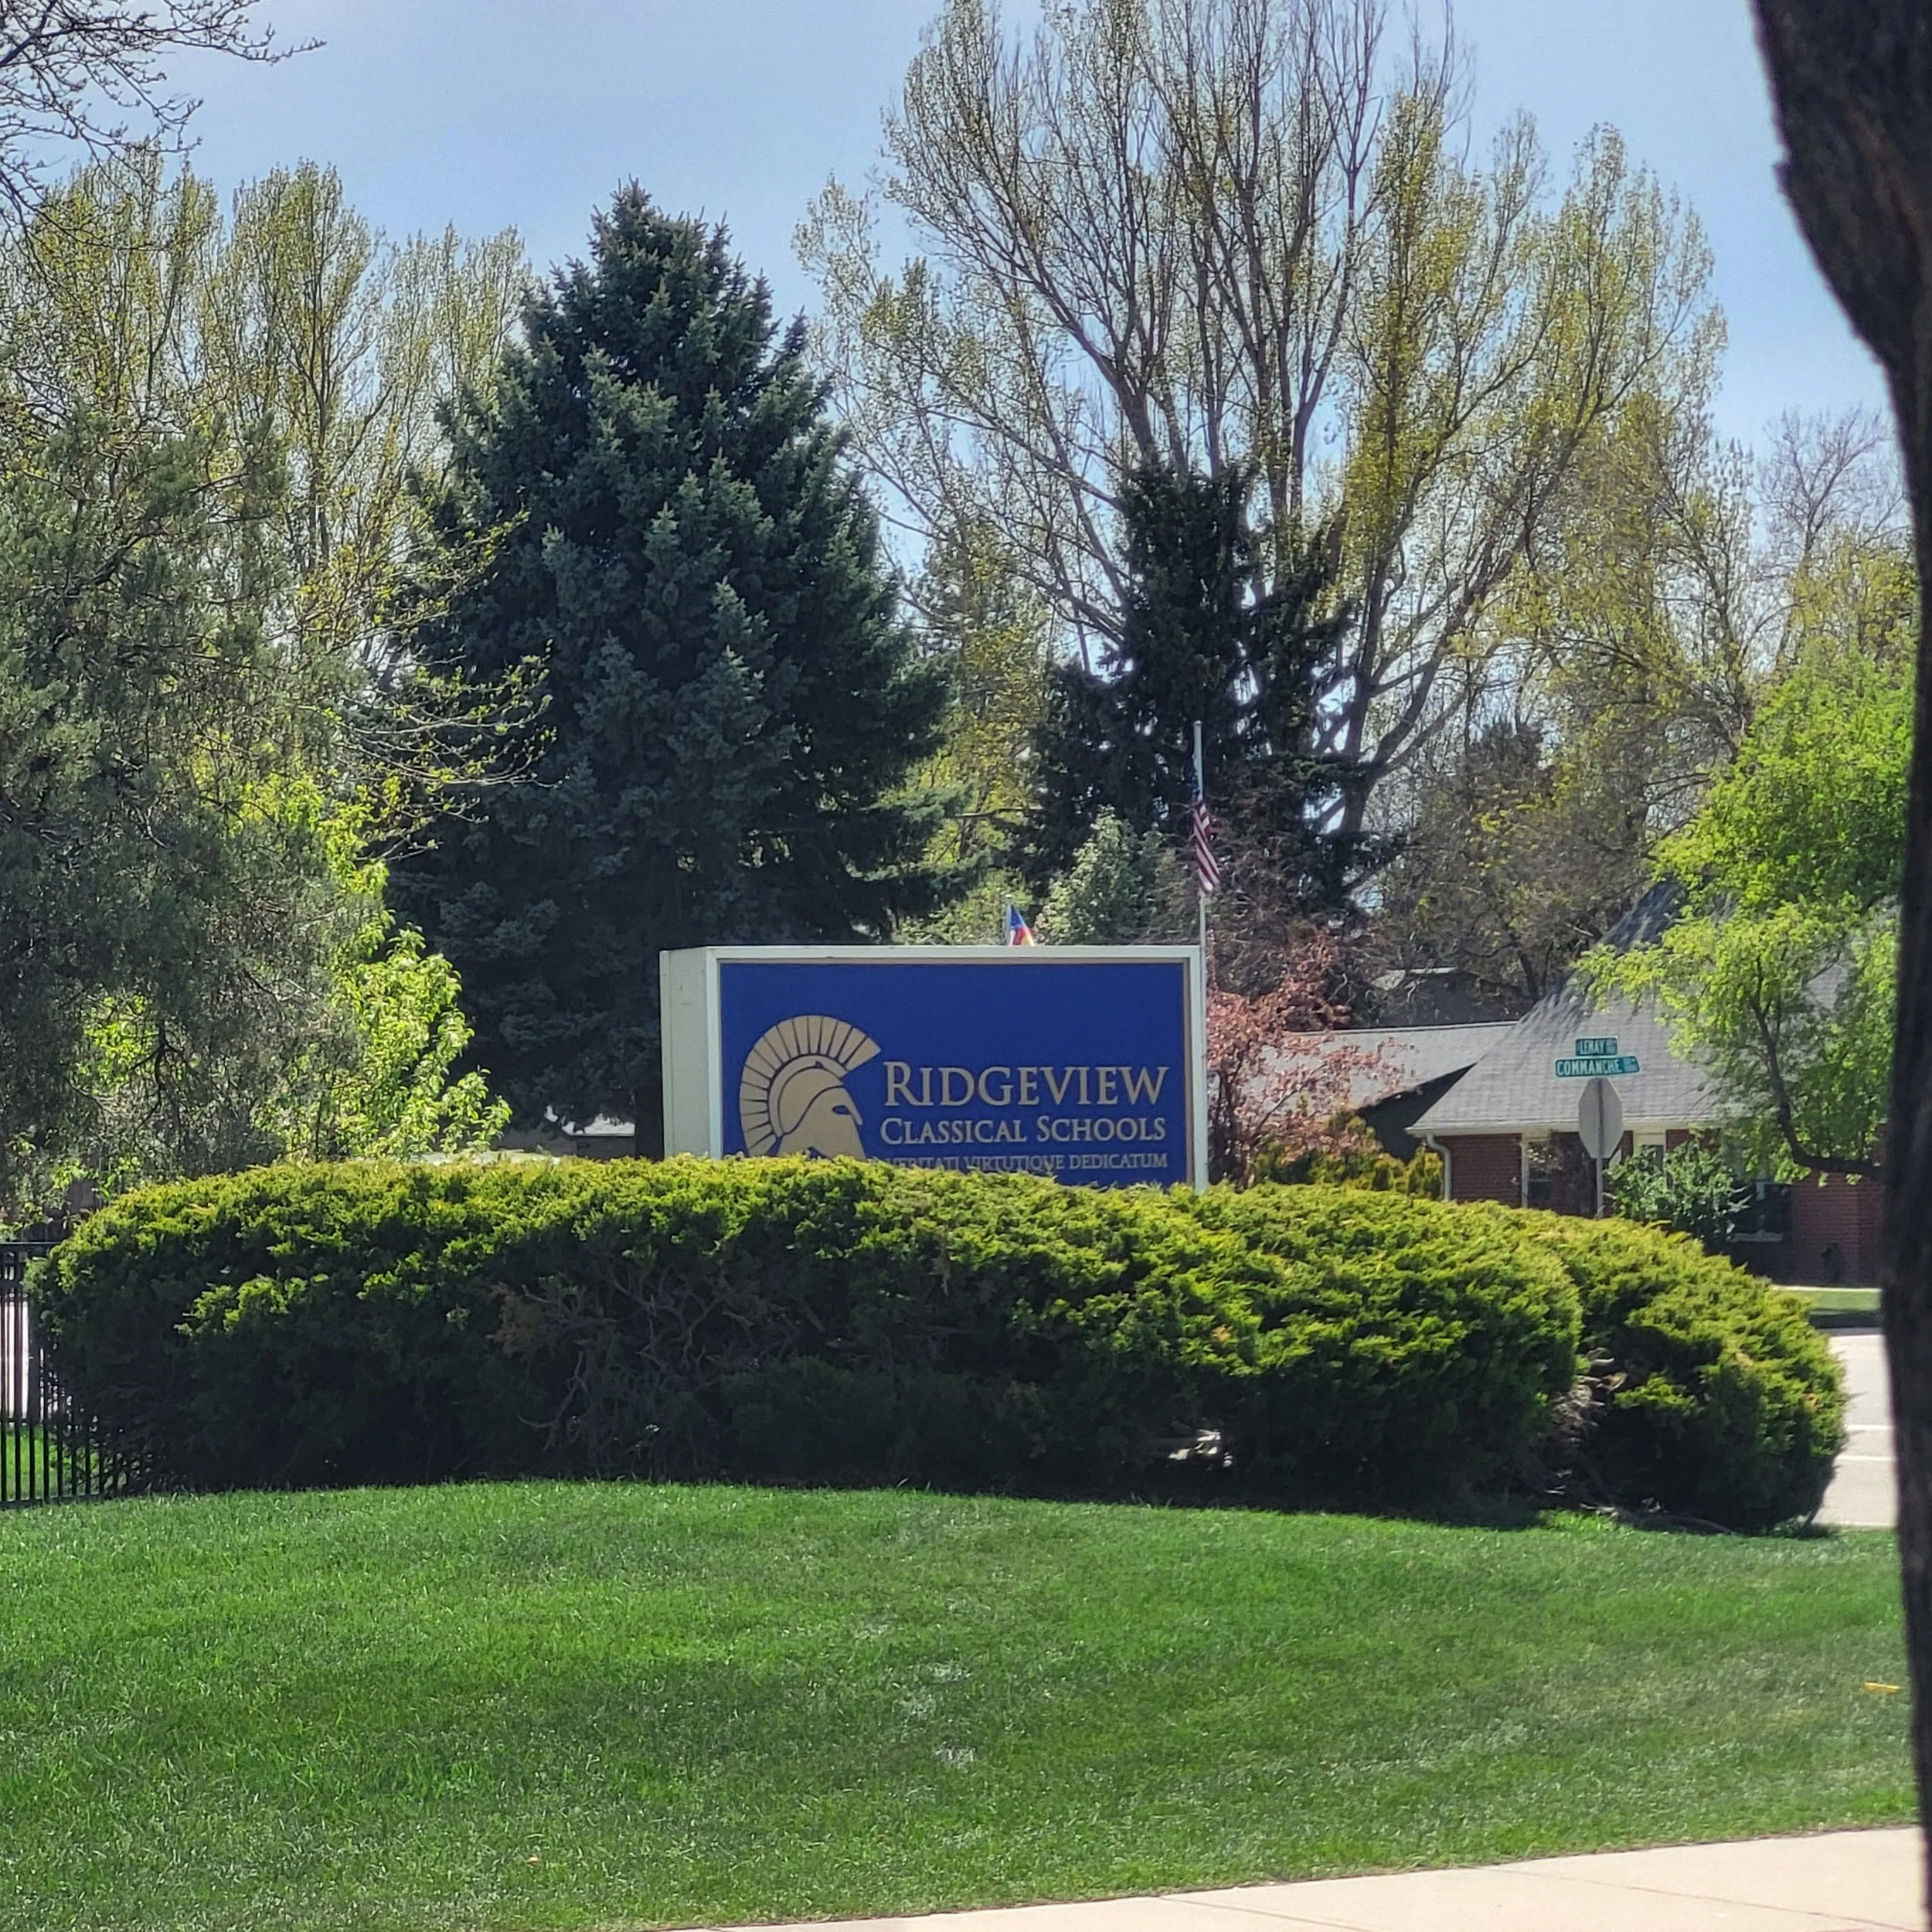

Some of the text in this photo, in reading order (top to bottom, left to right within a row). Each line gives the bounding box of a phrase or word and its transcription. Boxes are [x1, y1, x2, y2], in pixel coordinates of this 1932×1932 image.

[1557, 1059, 1623, 1077] COMMANCHE
[883, 1062, 1169, 1105] RIDGEVIEW
[879, 1115, 1166, 1145] CLASSICAL SCHOOLS
[1067, 1153, 1168, 1169] DEDICATUM
